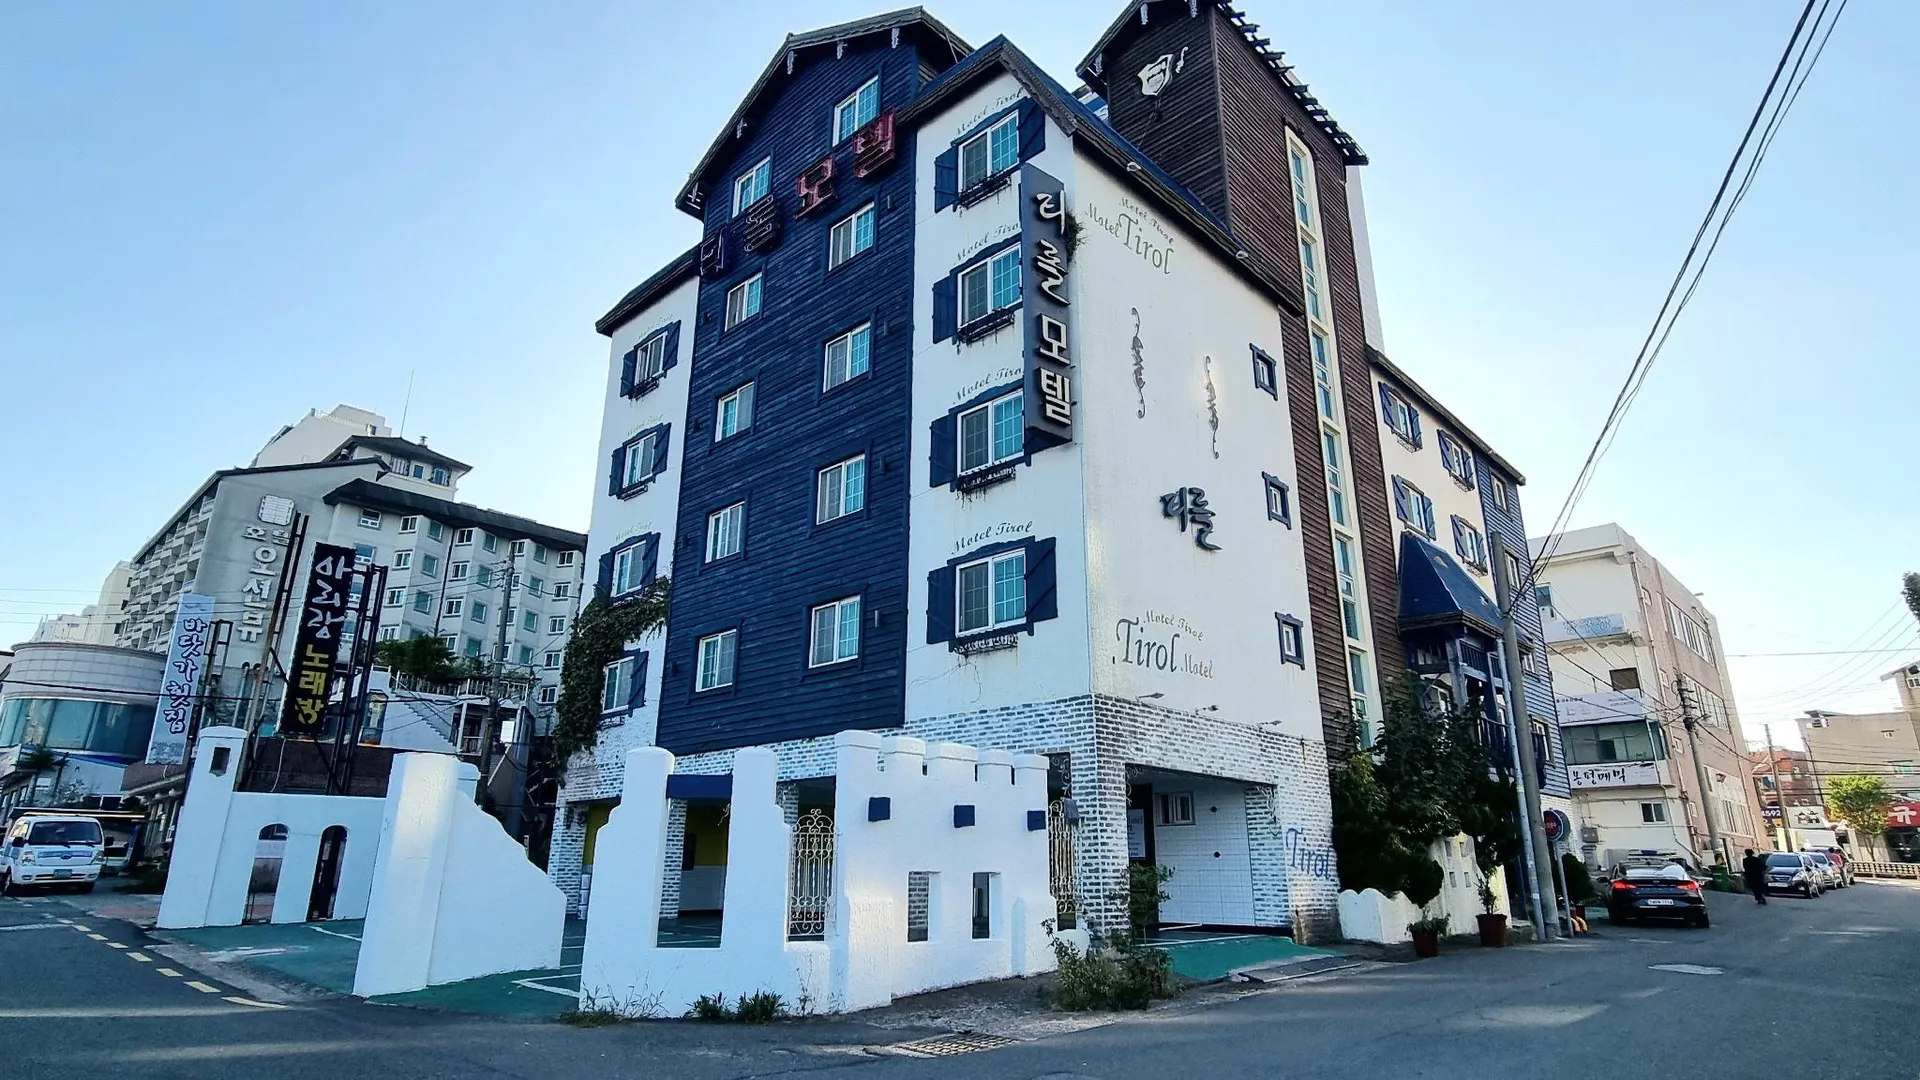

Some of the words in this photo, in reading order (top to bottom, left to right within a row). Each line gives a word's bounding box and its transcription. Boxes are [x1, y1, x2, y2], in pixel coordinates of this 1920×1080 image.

[993, 223, 1020, 238] Tiro
[1085, 203, 1119, 238] Motel
[1118, 213, 1174, 274] Tirol
[953, 373, 991, 404] Motel
[994, 367, 1022, 381] Tiro
[951, 526, 992, 555] Motel
[995, 520, 1033, 535] Tirol
[236, 547, 277, 642] 오션뷰
[308, 555, 352, 639] 아리랑
[1116, 617, 1180, 672] Tirol
[1286, 828, 1333, 880] Tirol
